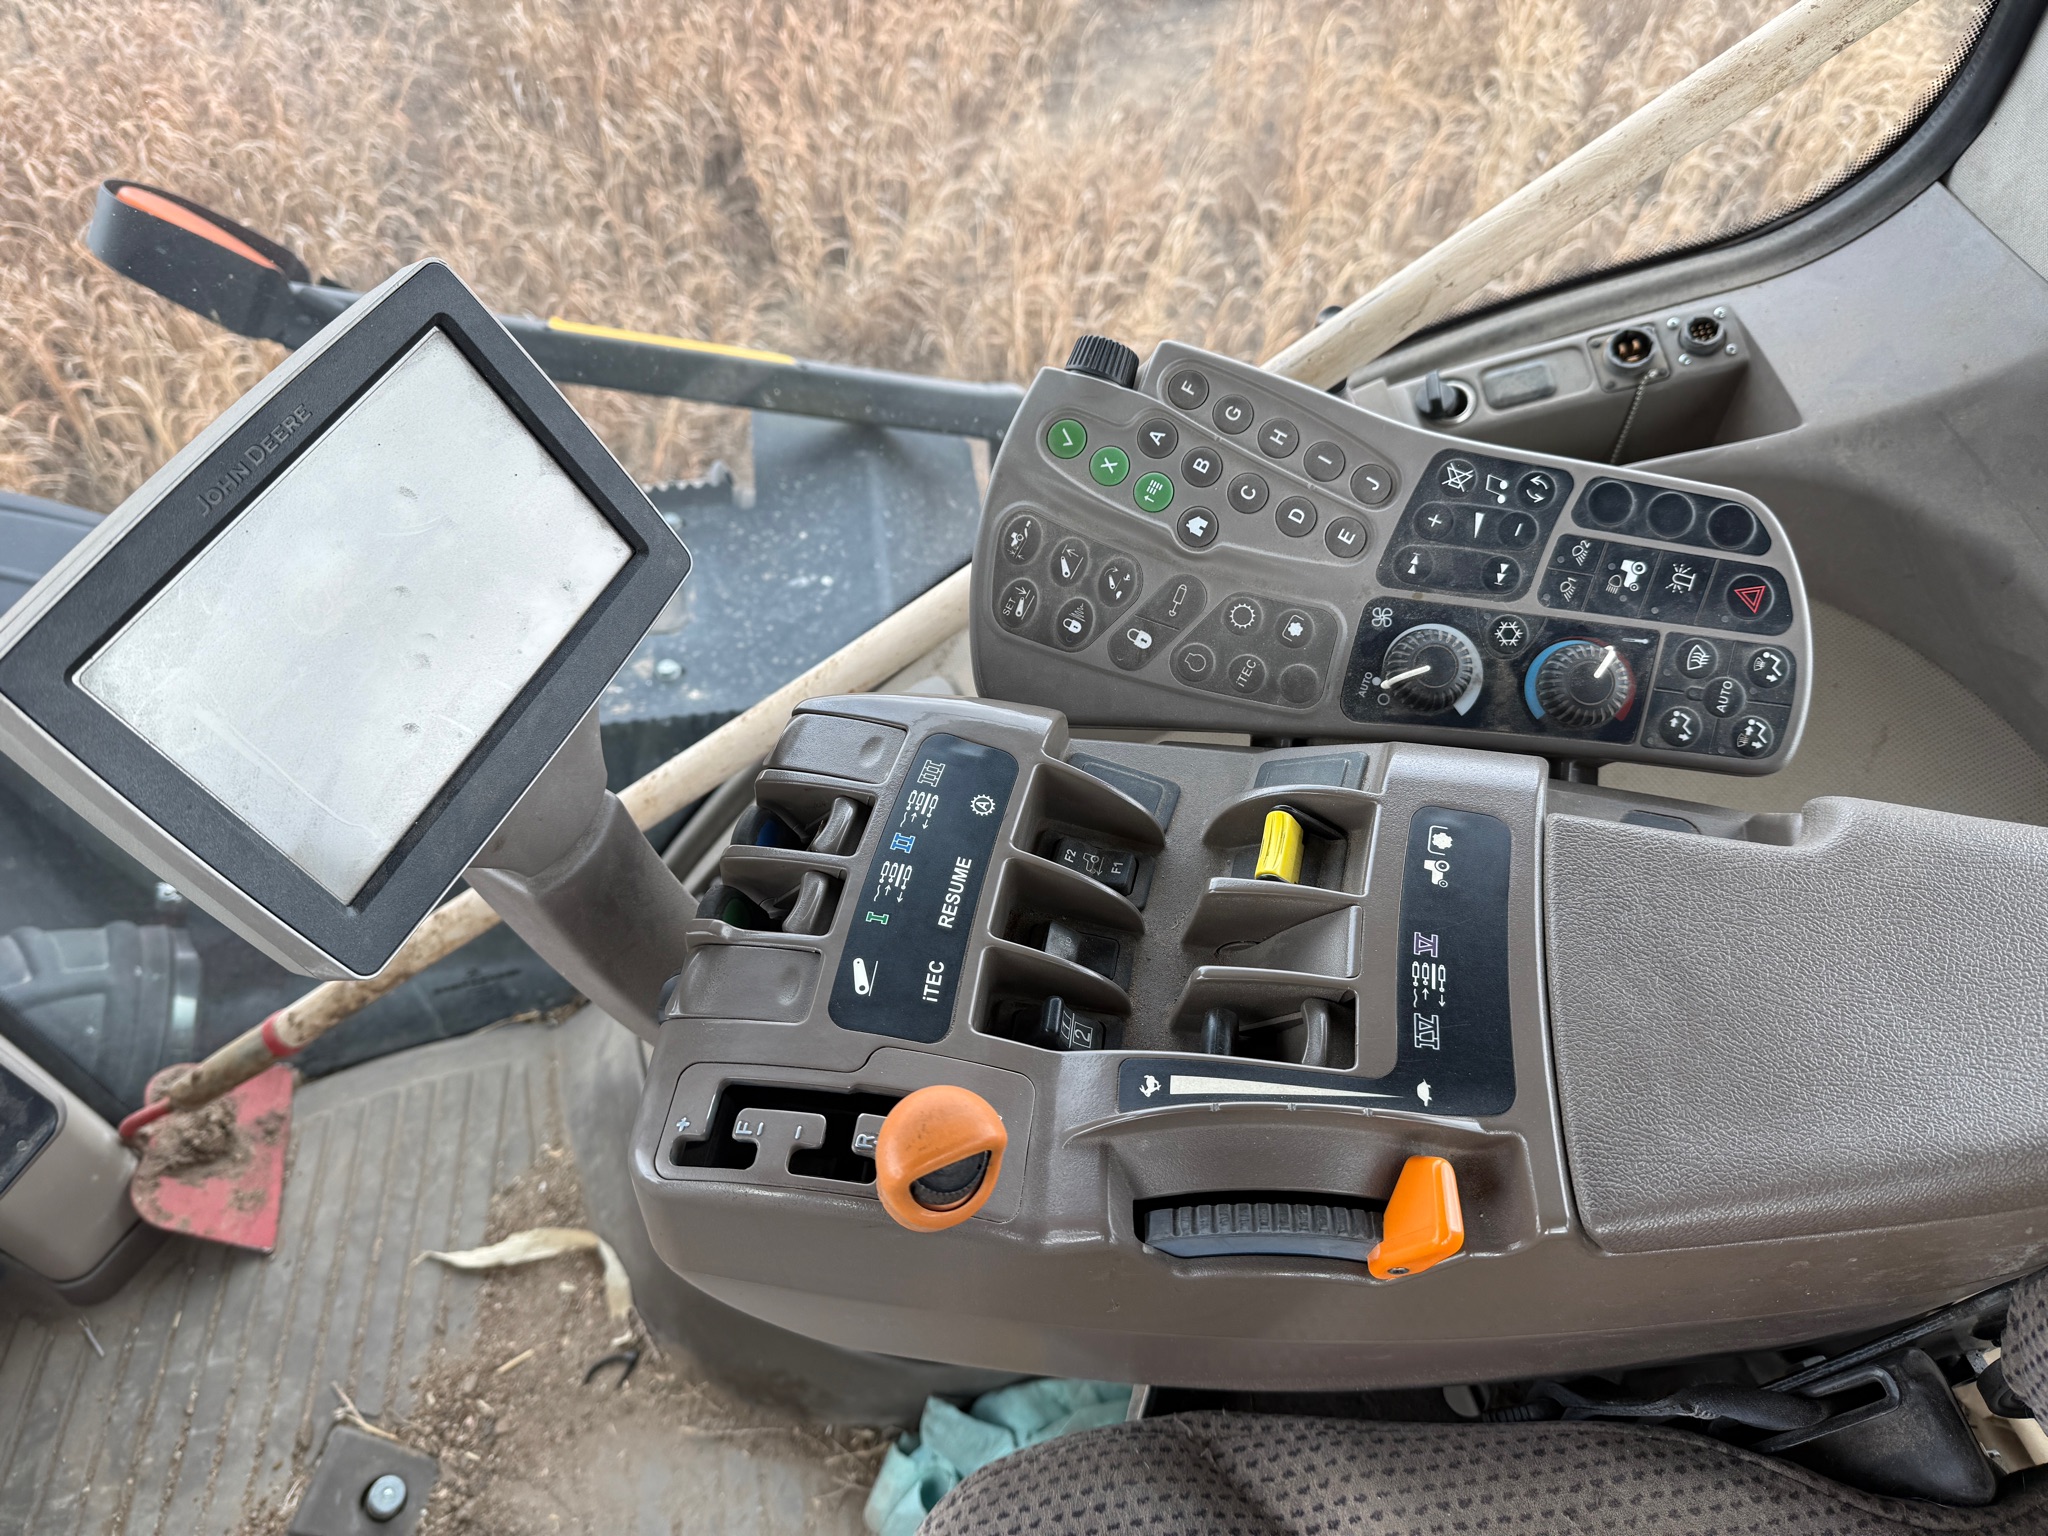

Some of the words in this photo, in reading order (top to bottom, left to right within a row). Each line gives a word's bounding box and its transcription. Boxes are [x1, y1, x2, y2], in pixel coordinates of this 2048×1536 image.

[1180, 381, 1196, 397] F
[1225, 405, 1242, 421] G
[1149, 430, 1166, 447] A
[1269, 429, 1288, 446] H
[196, 461, 252, 517] JOHN
[244, 403, 313, 466] DEERE
[1193, 458, 1210, 474] B
[1317, 453, 1333, 466] I
[1365, 477, 1380, 491] J
[1240, 485, 1256, 500] C
[1288, 508, 1305, 525] D
[1337, 528, 1357, 545] E
[1580, 540, 1591, 549] 2
[1002, 597, 1016, 616] SET
[1236, 659, 1257, 688] iTEC
[1357, 671, 1373, 698] AUTO
[1715, 680, 1733, 713] AUTO
[1064, 848, 1077, 863] F2
[1110, 861, 1124, 875] F1
[937, 856, 973, 929] RESUME
[922, 960, 945, 1003] iTEC
[1074, 1029, 1091, 1042] 2
[735, 1120, 753, 1136] F
[854, 1133, 875, 1149] R
